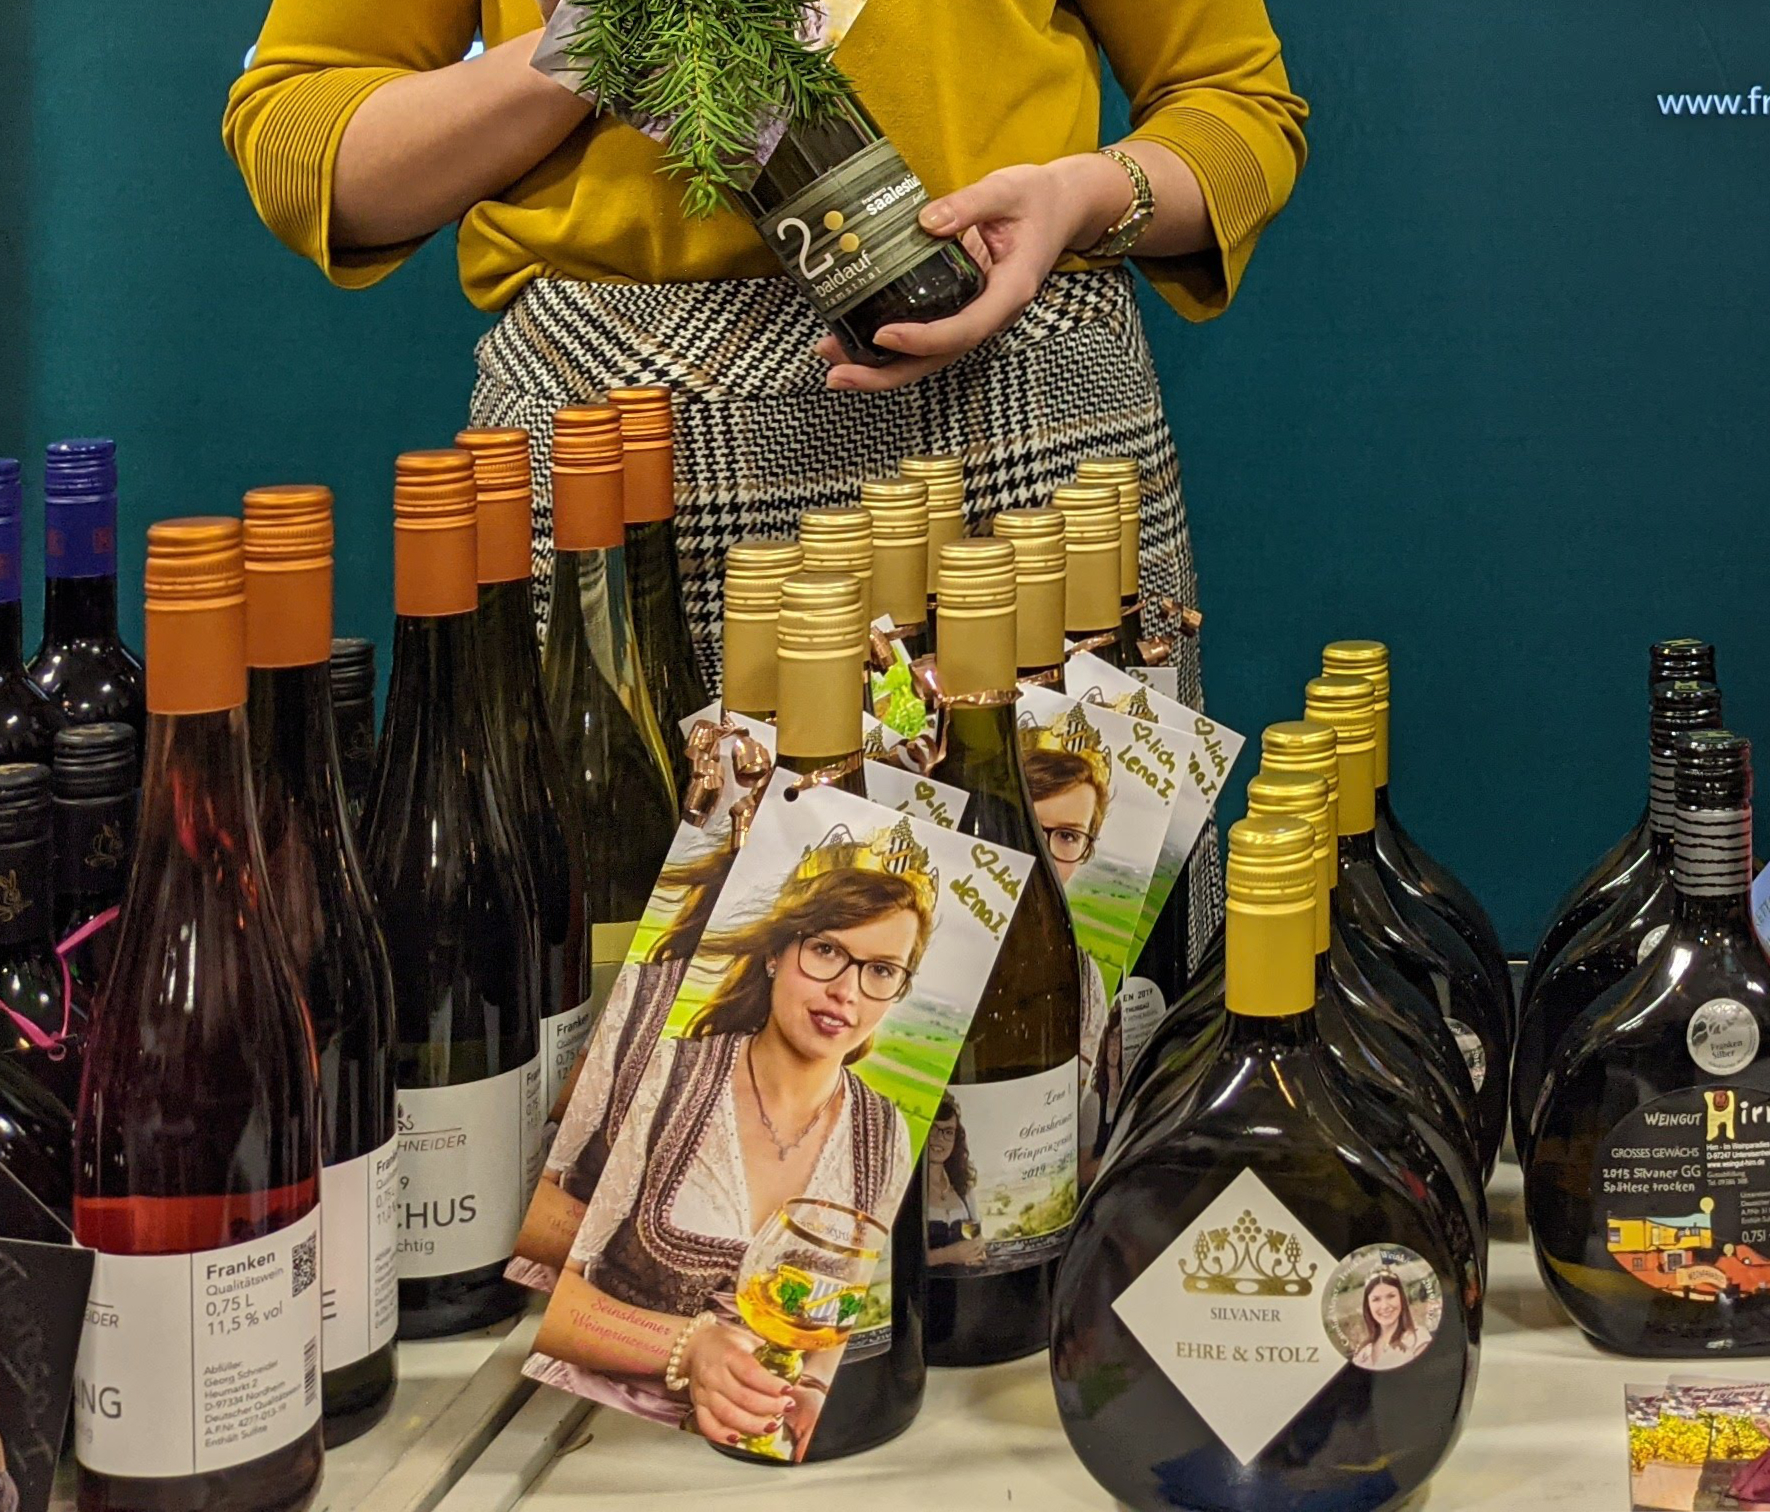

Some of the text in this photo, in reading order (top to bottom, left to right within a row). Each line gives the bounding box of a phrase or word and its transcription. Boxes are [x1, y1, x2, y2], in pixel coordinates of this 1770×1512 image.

[777, 217, 834, 279] 2
[811, 249, 872, 297] baldauf
[1644, 1112, 1702, 1127] WEINGUT
[1611, 1146, 1700, 1158] GROSSES GEWÄCHS
[1022, 1163, 1047, 1180] 2019
[1602, 1165, 1701, 1179] 2015 Silvaner GG
[1602, 1180, 1696, 1194] Spätlese trocken
[397, 1194, 477, 1230] HUS
[205, 1252, 276, 1281] Franken
[205, 1266, 285, 1297] Qualitätswein
[205, 1292, 255, 1317] 0,75 L
[591, 1296, 671, 1336] Seinsheimer
[1209, 1307, 1282, 1323] SILVANER
[207, 1301, 284, 1337] 11,5 % vol
[1175, 1341, 1320, 1364] EHRE & STOLZ
[203, 1360, 278, 1388] Georg Schneider
[204, 1378, 259, 1399] Heumarkt 2
[204, 1396, 244, 1413] D-97334
[204, 1406, 252, 1425] Deutscher
